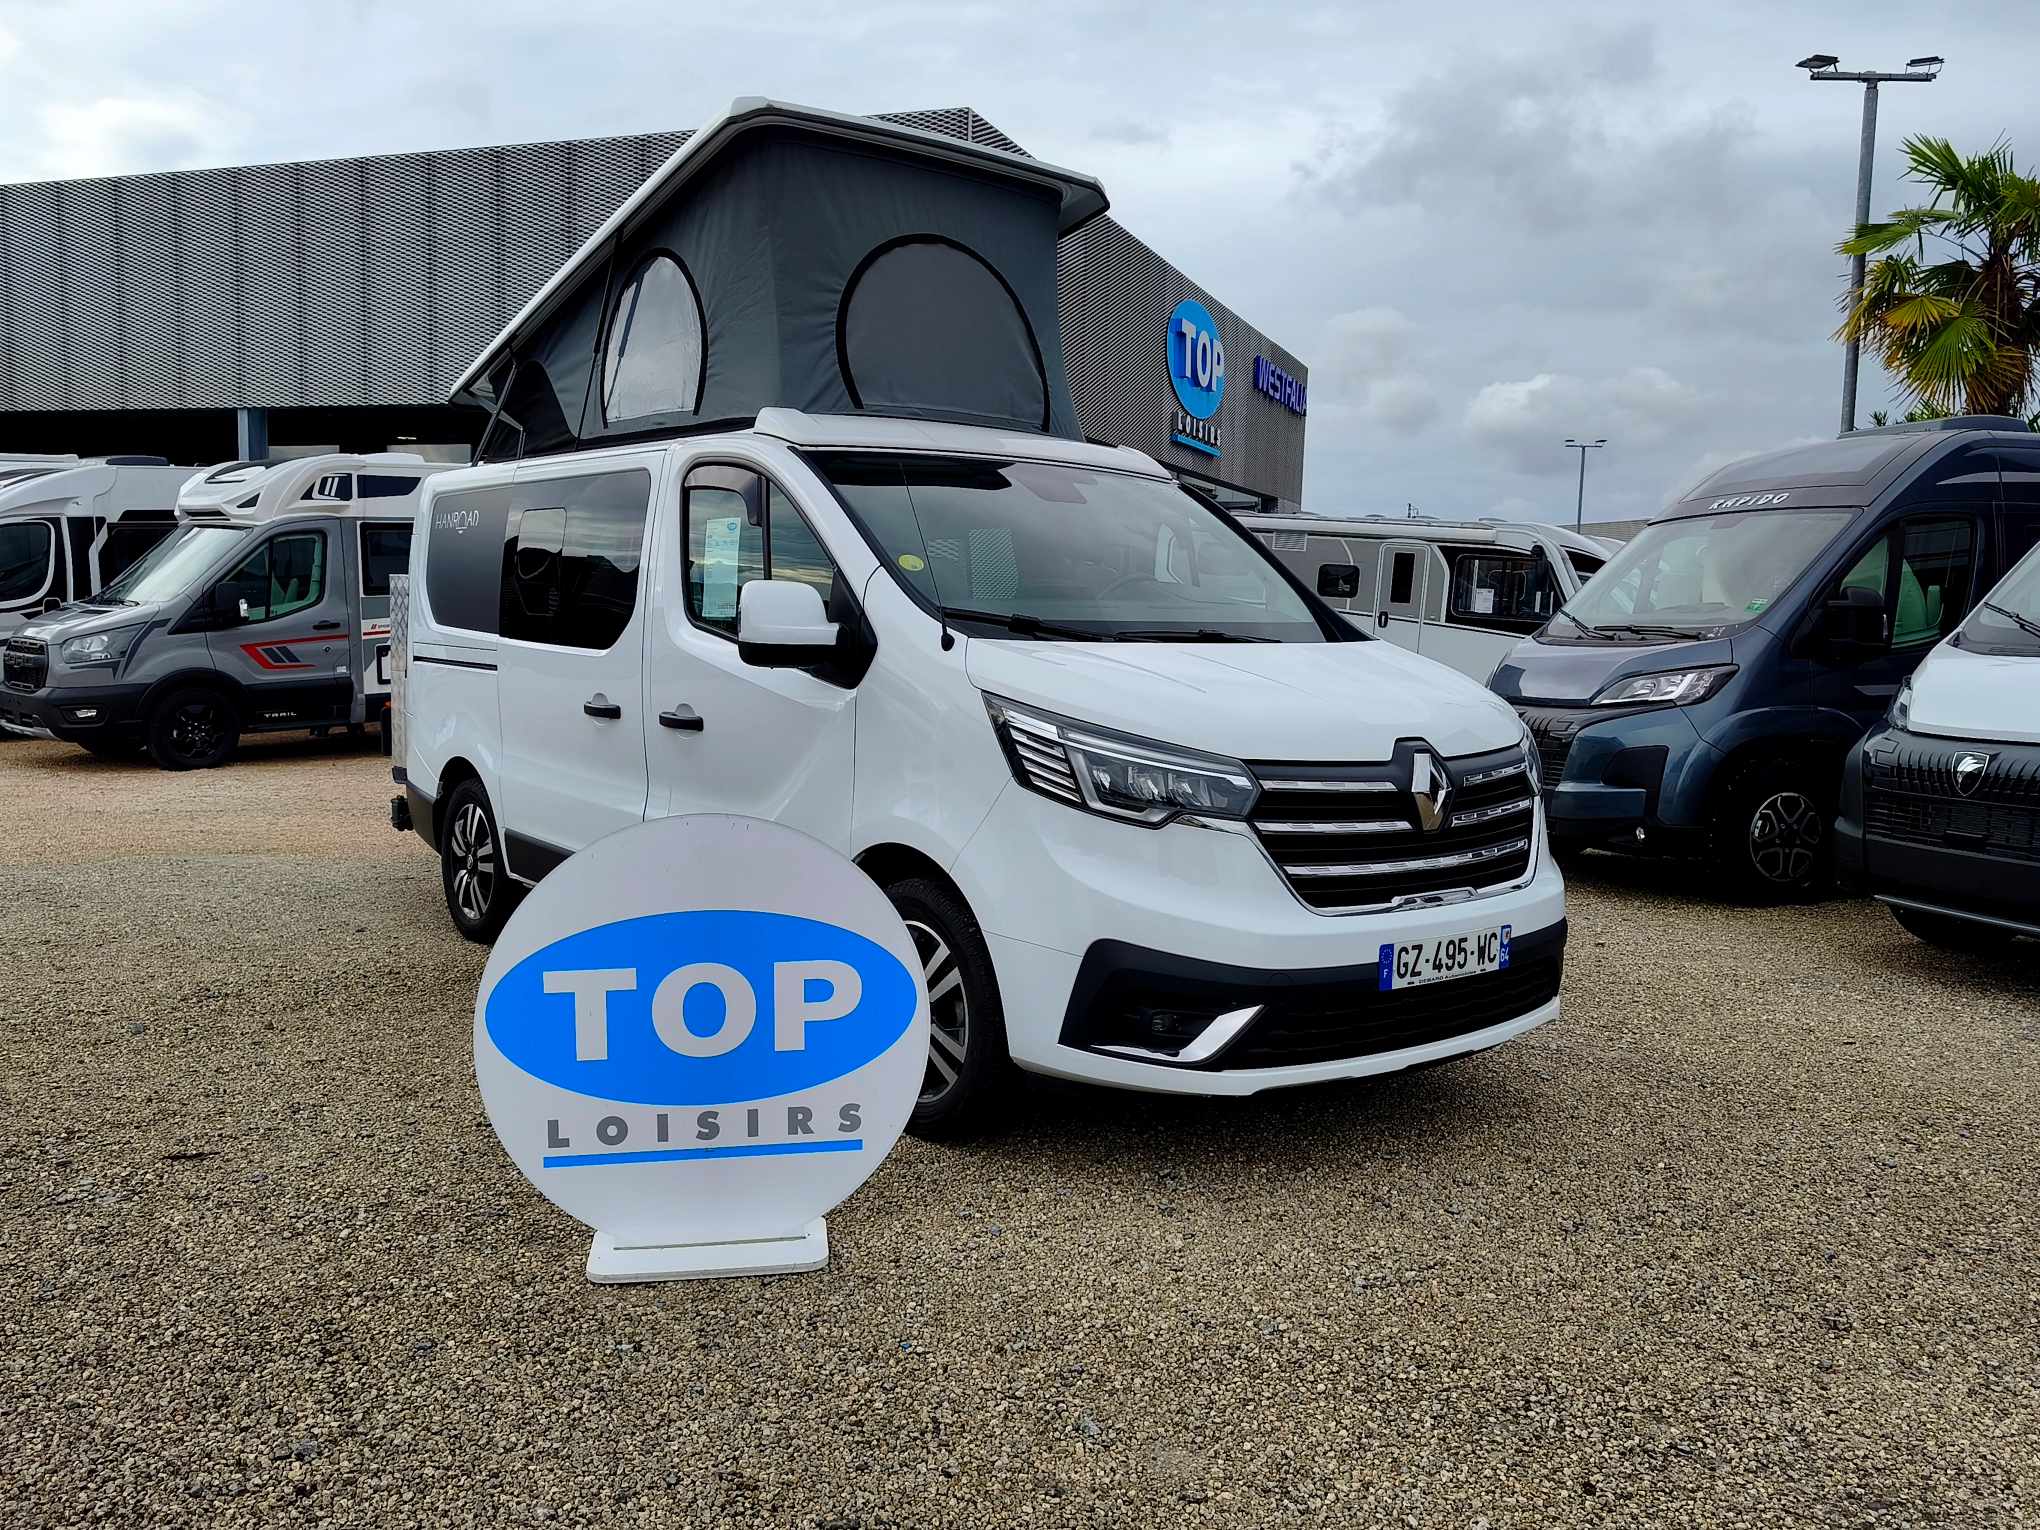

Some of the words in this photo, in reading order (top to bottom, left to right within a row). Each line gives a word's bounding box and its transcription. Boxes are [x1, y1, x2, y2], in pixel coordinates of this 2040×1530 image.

[1181, 318, 1225, 392] TOP
[1254, 354, 1307, 415] WESTFALIA
[1177, 411, 1221, 447] LOISIRS
[1707, 492, 1790, 510] RAPIDO
[263, 711, 297, 719] TRAIL
[1395, 932, 1498, 979] GZ-495-WC
[1500, 947, 1509, 962] 64
[543, 959, 863, 1061] TOP
[547, 1103, 862, 1149] LOISIRS
